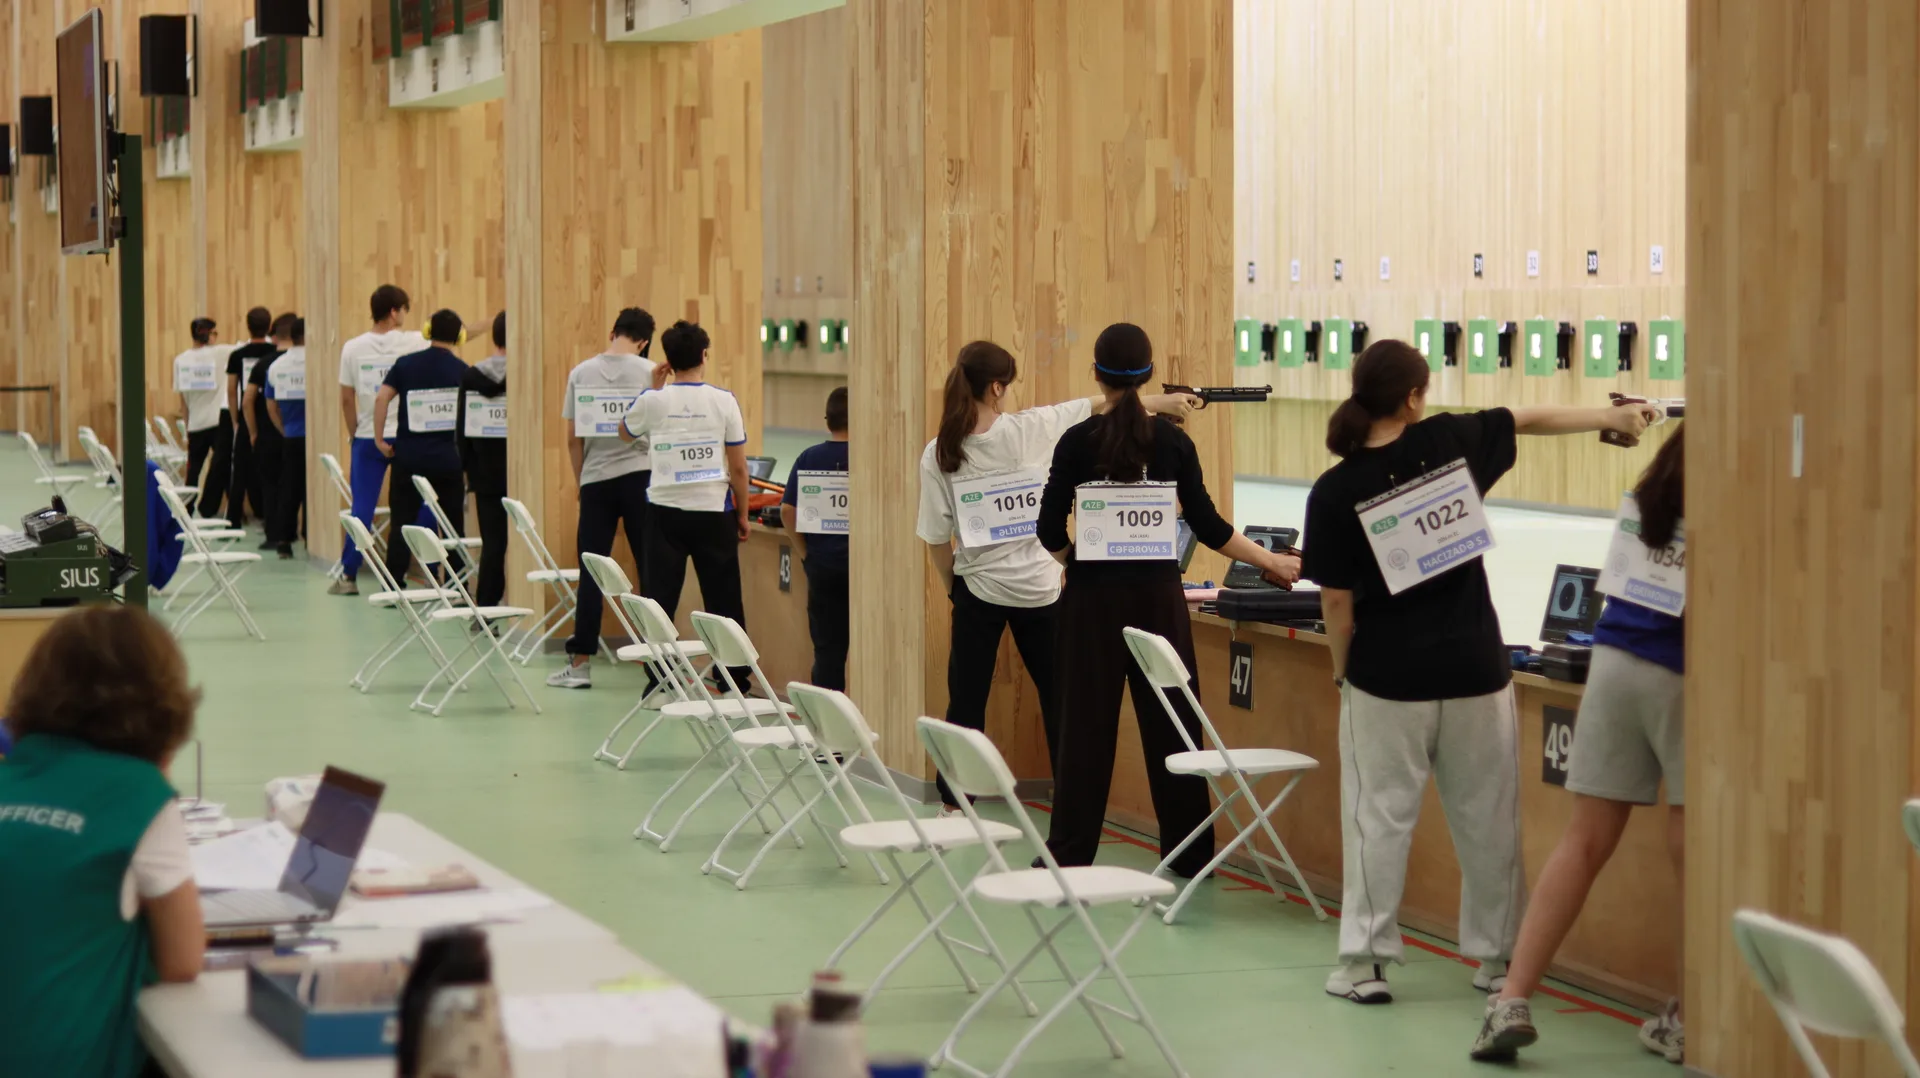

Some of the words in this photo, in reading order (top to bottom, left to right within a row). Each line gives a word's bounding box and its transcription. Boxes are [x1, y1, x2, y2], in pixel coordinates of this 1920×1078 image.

[428, 403, 453, 414] 1042
[680, 446, 714, 461] 1039
[964, 493, 980, 502] AZE
[993, 492, 1037, 512] 1016
[1084, 501, 1101, 509] AZE
[823, 521, 849, 529] RAMAZ
[1115, 510, 1163, 527] 1009
[1375, 517, 1396, 533] AZE
[1414, 498, 1469, 536] 1022
[998, 524, 1033, 537] ƏLİYEVA
[1109, 545, 1160, 554] CƏFƏROVA
[1646, 545, 1686, 571] 1034
[60, 566, 100, 588] SIUS
[779, 554, 790, 583] 43
[1231, 655, 1251, 695] 47
[1545, 722, 1573, 772] 49
[0, 806, 84, 834] FFICER
